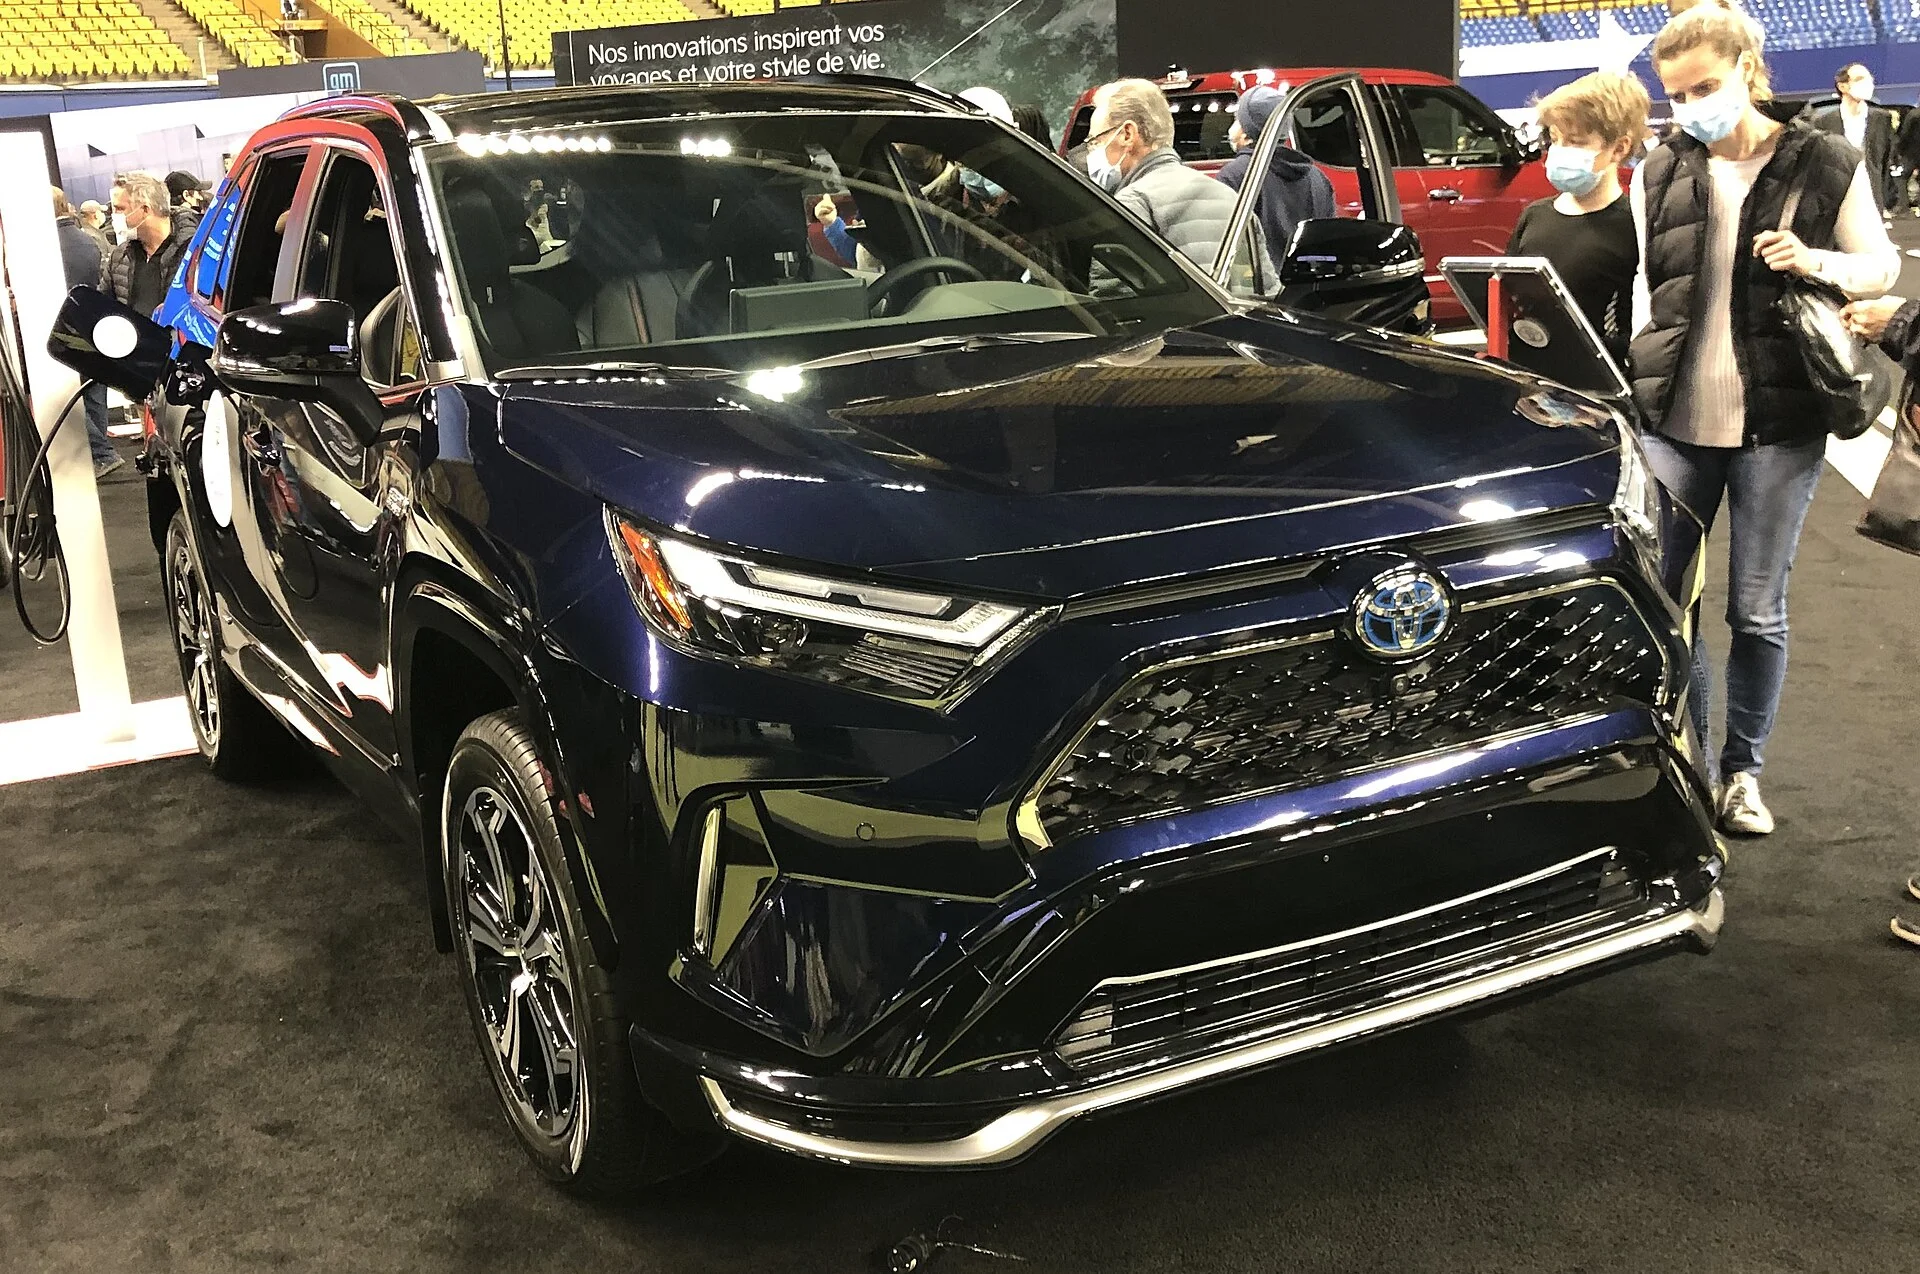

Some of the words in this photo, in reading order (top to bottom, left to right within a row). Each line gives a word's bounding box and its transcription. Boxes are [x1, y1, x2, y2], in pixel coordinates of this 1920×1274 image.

[588, 43, 628, 65] Nos
[633, 35, 748, 61] innovations
[754, 24, 842, 55] inspirent
[847, 24, 885, 44] vos
[330, 72, 354, 90] gm
[677, 63, 698, 83] et
[703, 61, 756, 82] votre
[762, 54, 811, 79] style
[816, 51, 844, 74] de
[849, 49, 886, 71] vie.
